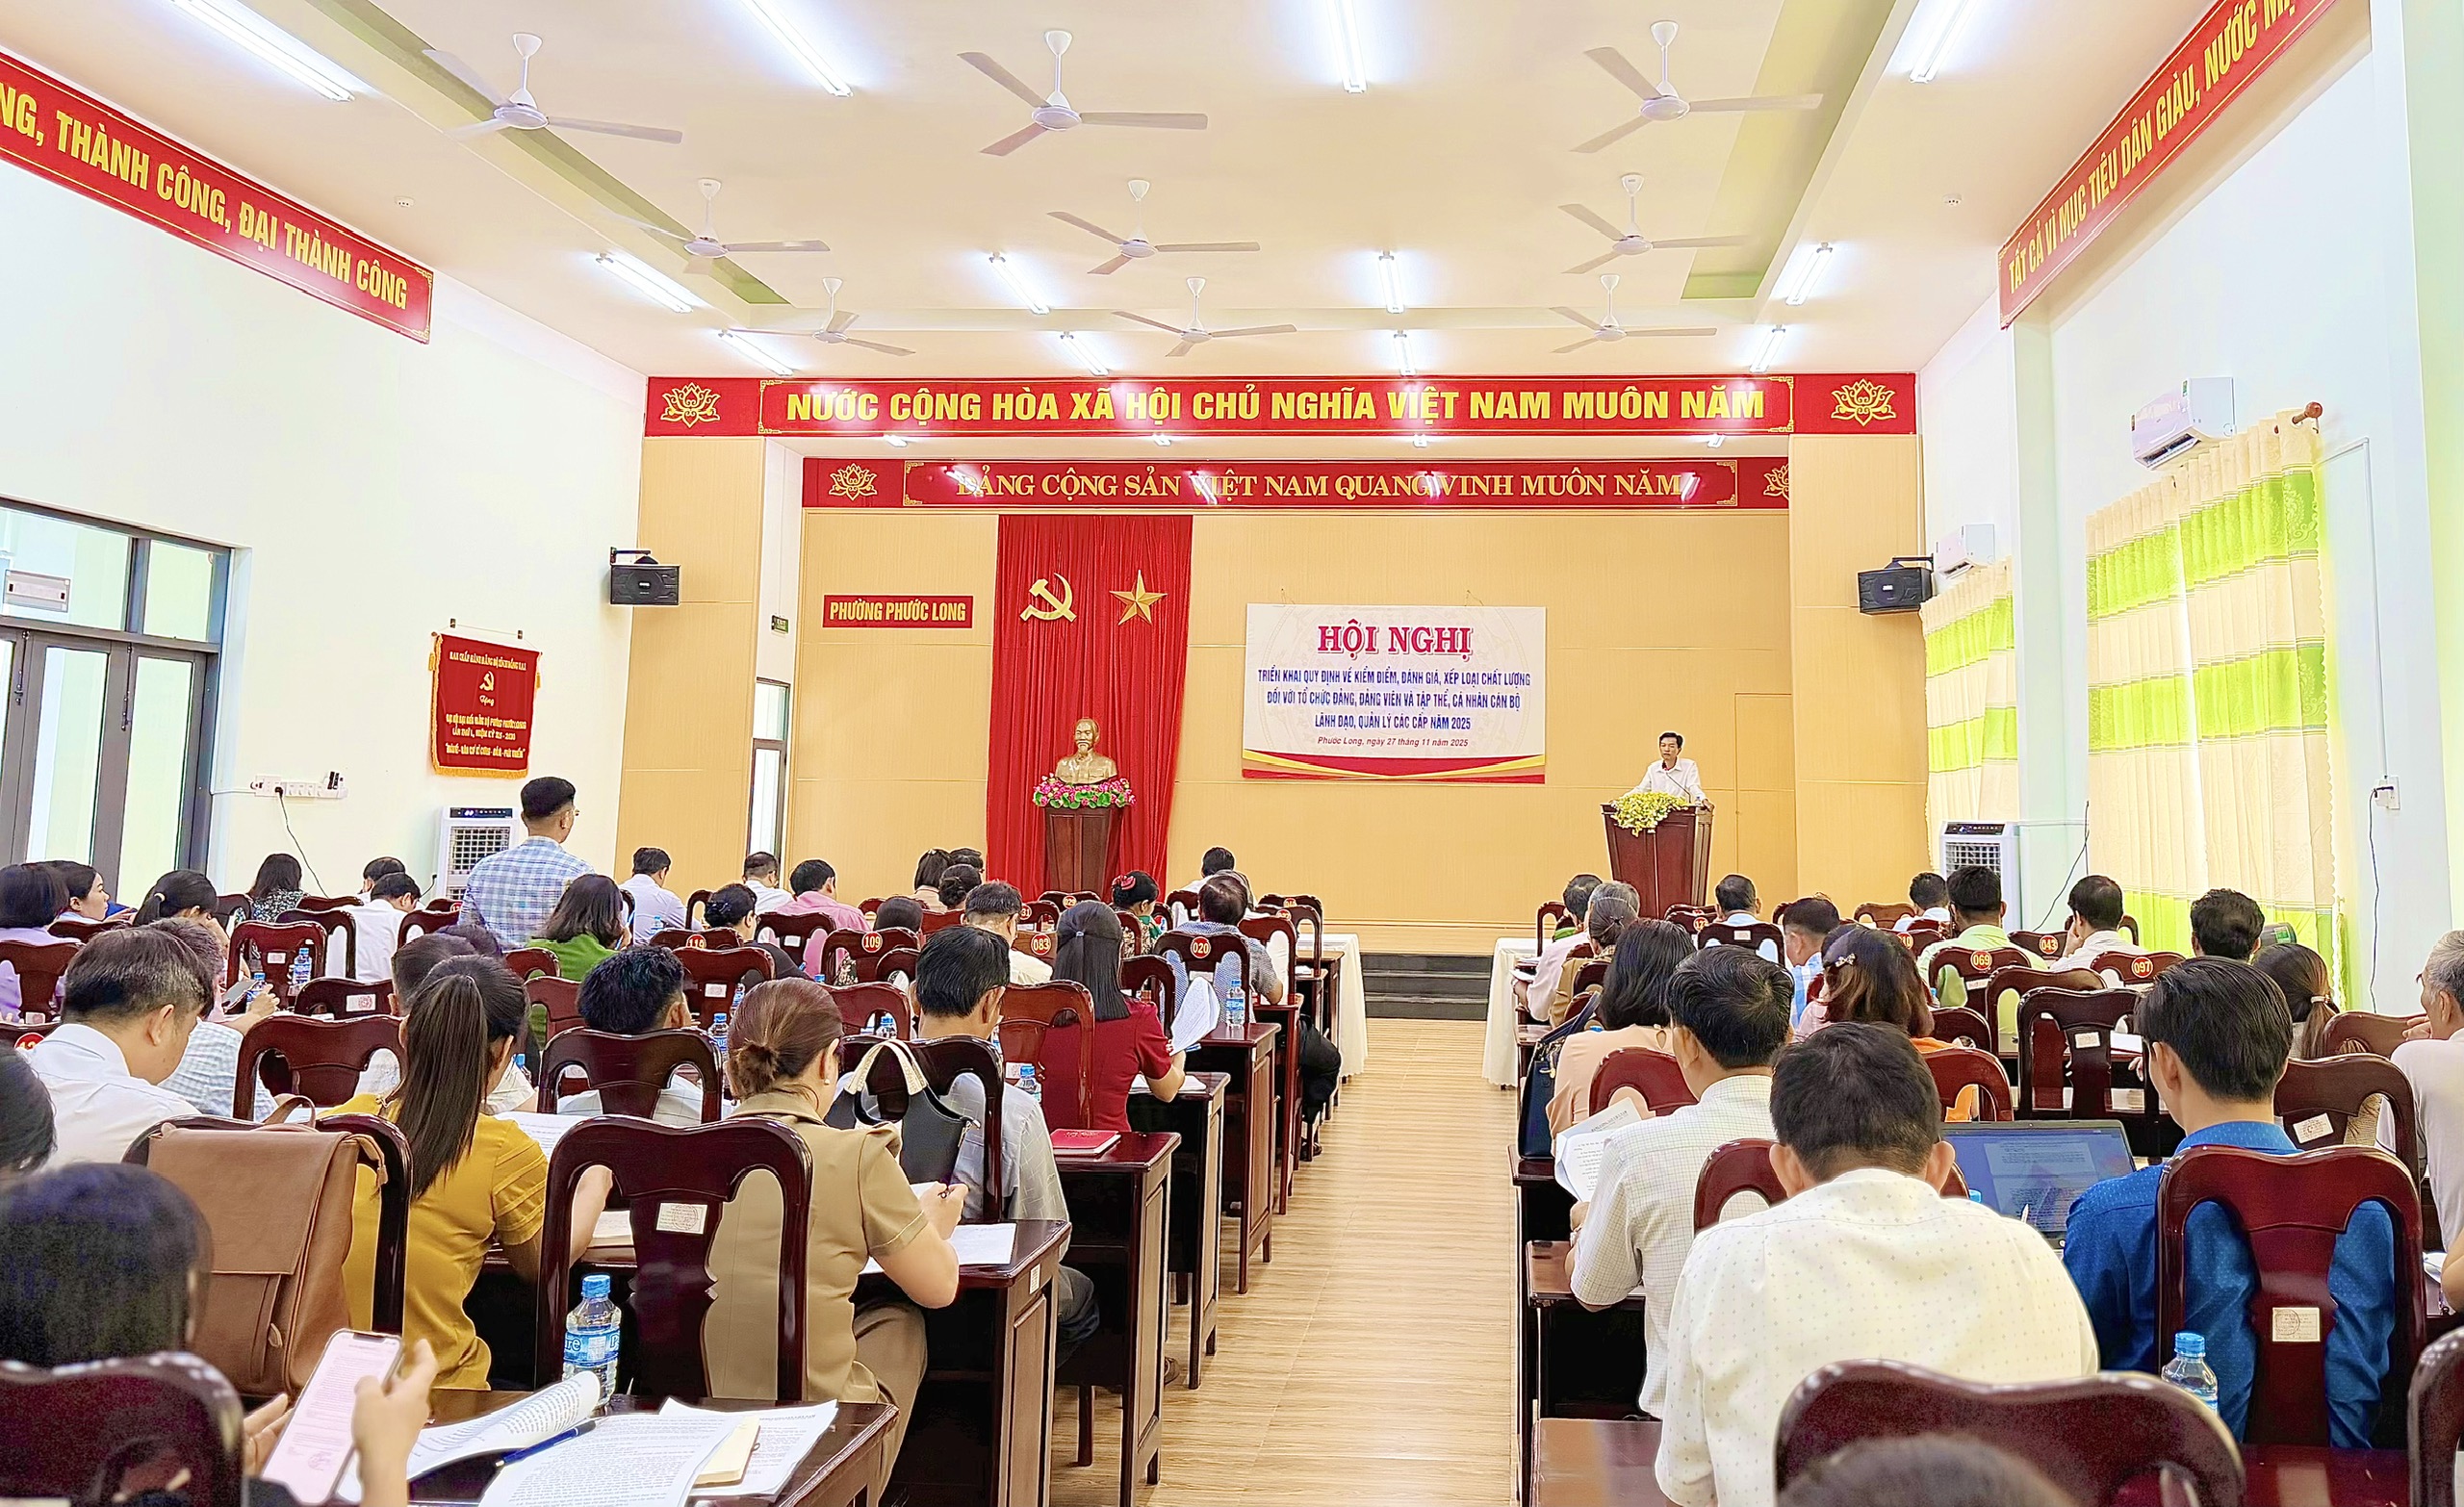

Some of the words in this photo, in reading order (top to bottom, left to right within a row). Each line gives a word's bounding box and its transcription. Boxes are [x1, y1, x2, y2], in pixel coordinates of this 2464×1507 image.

[2009, 242, 2027, 294] TẤT
[2028, 219, 2044, 273] CẢ
[2044, 208, 2057, 256] VÌ
[2058, 184, 2087, 243] MỤC
[2088, 147, 2118, 210] TIÊU
[2120, 116, 2152, 178] DÂN
[2156, 64, 2201, 141] GIÀU,
[2204, 0, 2258, 91] NƯỚC
[56, 110, 150, 191] THÀNH
[156, 163, 232, 234] CÔNG,
[239, 201, 278, 252] ĐẠI
[284, 221, 351, 284] THÀNH
[356, 259, 408, 310] CÔNG
[786, 388, 879, 421] NƯỚC
[889, 387, 982, 426] CỘNG
[992, 387, 1060, 421] HÒA
[1069, 387, 1116, 420] XÃ
[1125, 387, 1181, 425] HỘI
[1193, 383, 1260, 421] CHỦ
[1270, 387, 1377, 420] NGHĨA
[1387, 386, 1460, 425] VIỆT
[1469, 391, 1551, 420] NAM
[1562, 386, 1670, 420] MUÔN
[1681, 385, 1765, 419] NĂM
[1041, 467, 1117, 501] CỘNG
[1124, 466, 1183, 497] SẢN
[1264, 475, 1329, 497] NAM
[1336, 474, 1431, 500] QUANG
[1437, 474, 1514, 496] VINH
[1520, 467, 1606, 497] MUÔN
[1613, 467, 1682, 497] NĂM
[830, 598, 884, 622] PHƯỜNG
[885, 599, 929, 622] PHƯỚC
[931, 602, 966, 622] LONG
[1317, 619, 1378, 659] HỘI
[1388, 626, 1472, 661] NGHỊ
[1282, 670, 1301, 682] KHAI
[1303, 670, 1320, 683] QUY
[1321, 670, 1341, 685] ĐỊNH
[1461, 672, 1479, 688] LOẠI
[1450, 716, 1472, 729] 2025
[864, 935, 881, 948] 109
[1032, 938, 1049, 951] 083
[1193, 941, 1209, 953] 020
[2040, 939, 2057, 951] 043
[1973, 956, 1990, 966] 069
[2134, 961, 2151, 974] 097
